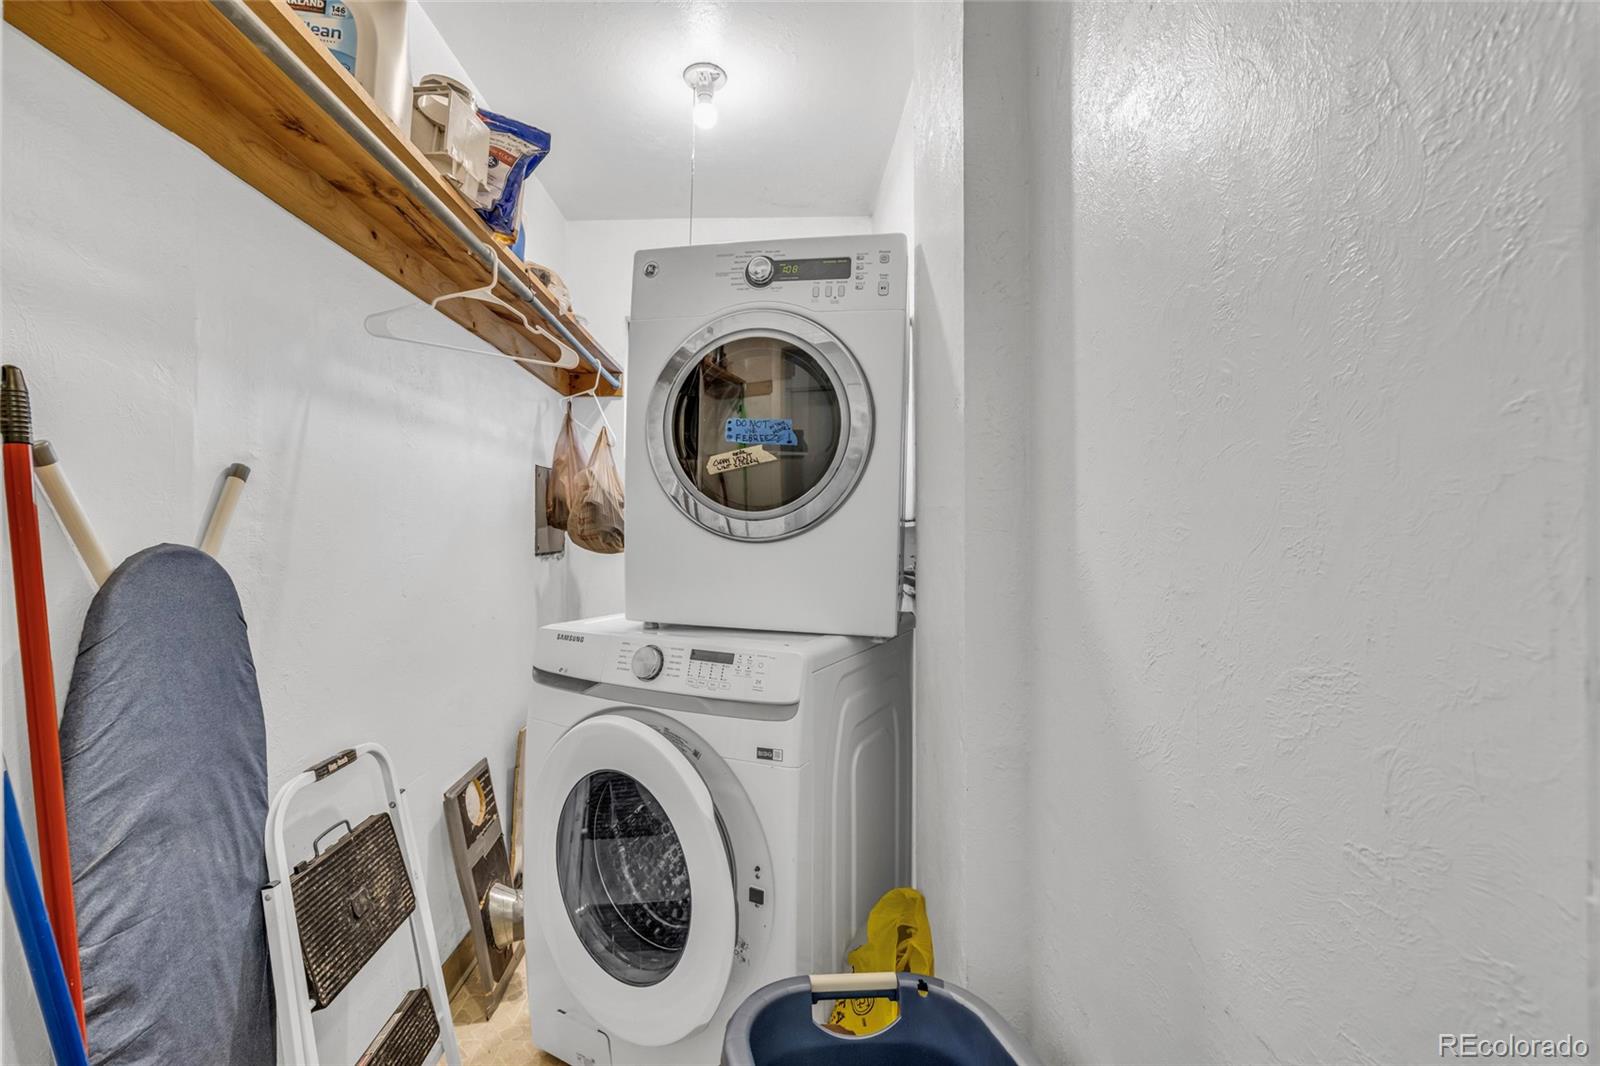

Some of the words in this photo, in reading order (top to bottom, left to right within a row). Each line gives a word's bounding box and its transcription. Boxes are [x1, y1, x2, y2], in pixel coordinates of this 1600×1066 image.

[735, 419, 747, 428] DO
[750, 419, 770, 429] NOT
[556, 633, 585, 643] SAMSUNG
